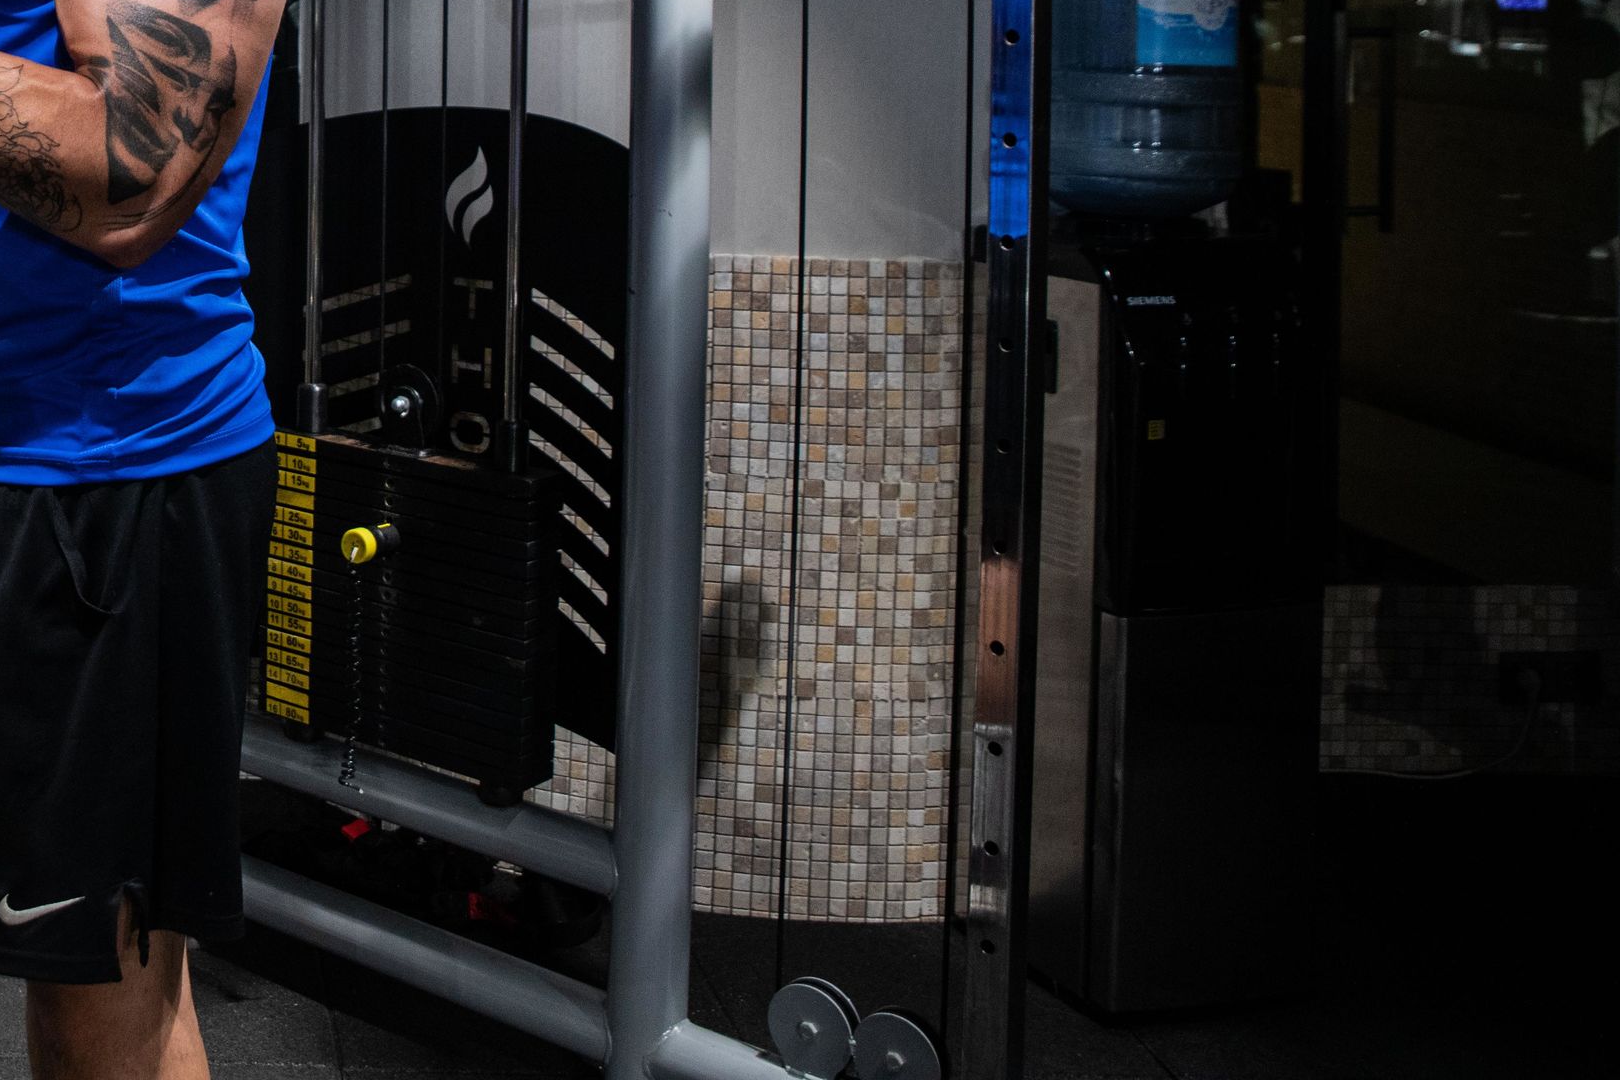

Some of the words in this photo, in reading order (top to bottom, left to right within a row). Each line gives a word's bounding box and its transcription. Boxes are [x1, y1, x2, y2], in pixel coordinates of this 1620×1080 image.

[1125, 295, 1178, 307] SIEMENS
[269, 598, 280, 609] 10
[270, 613, 279, 624] 11
[269, 632, 279, 643] 12
[268, 651, 279, 661] 13
[268, 668, 278, 678] 14
